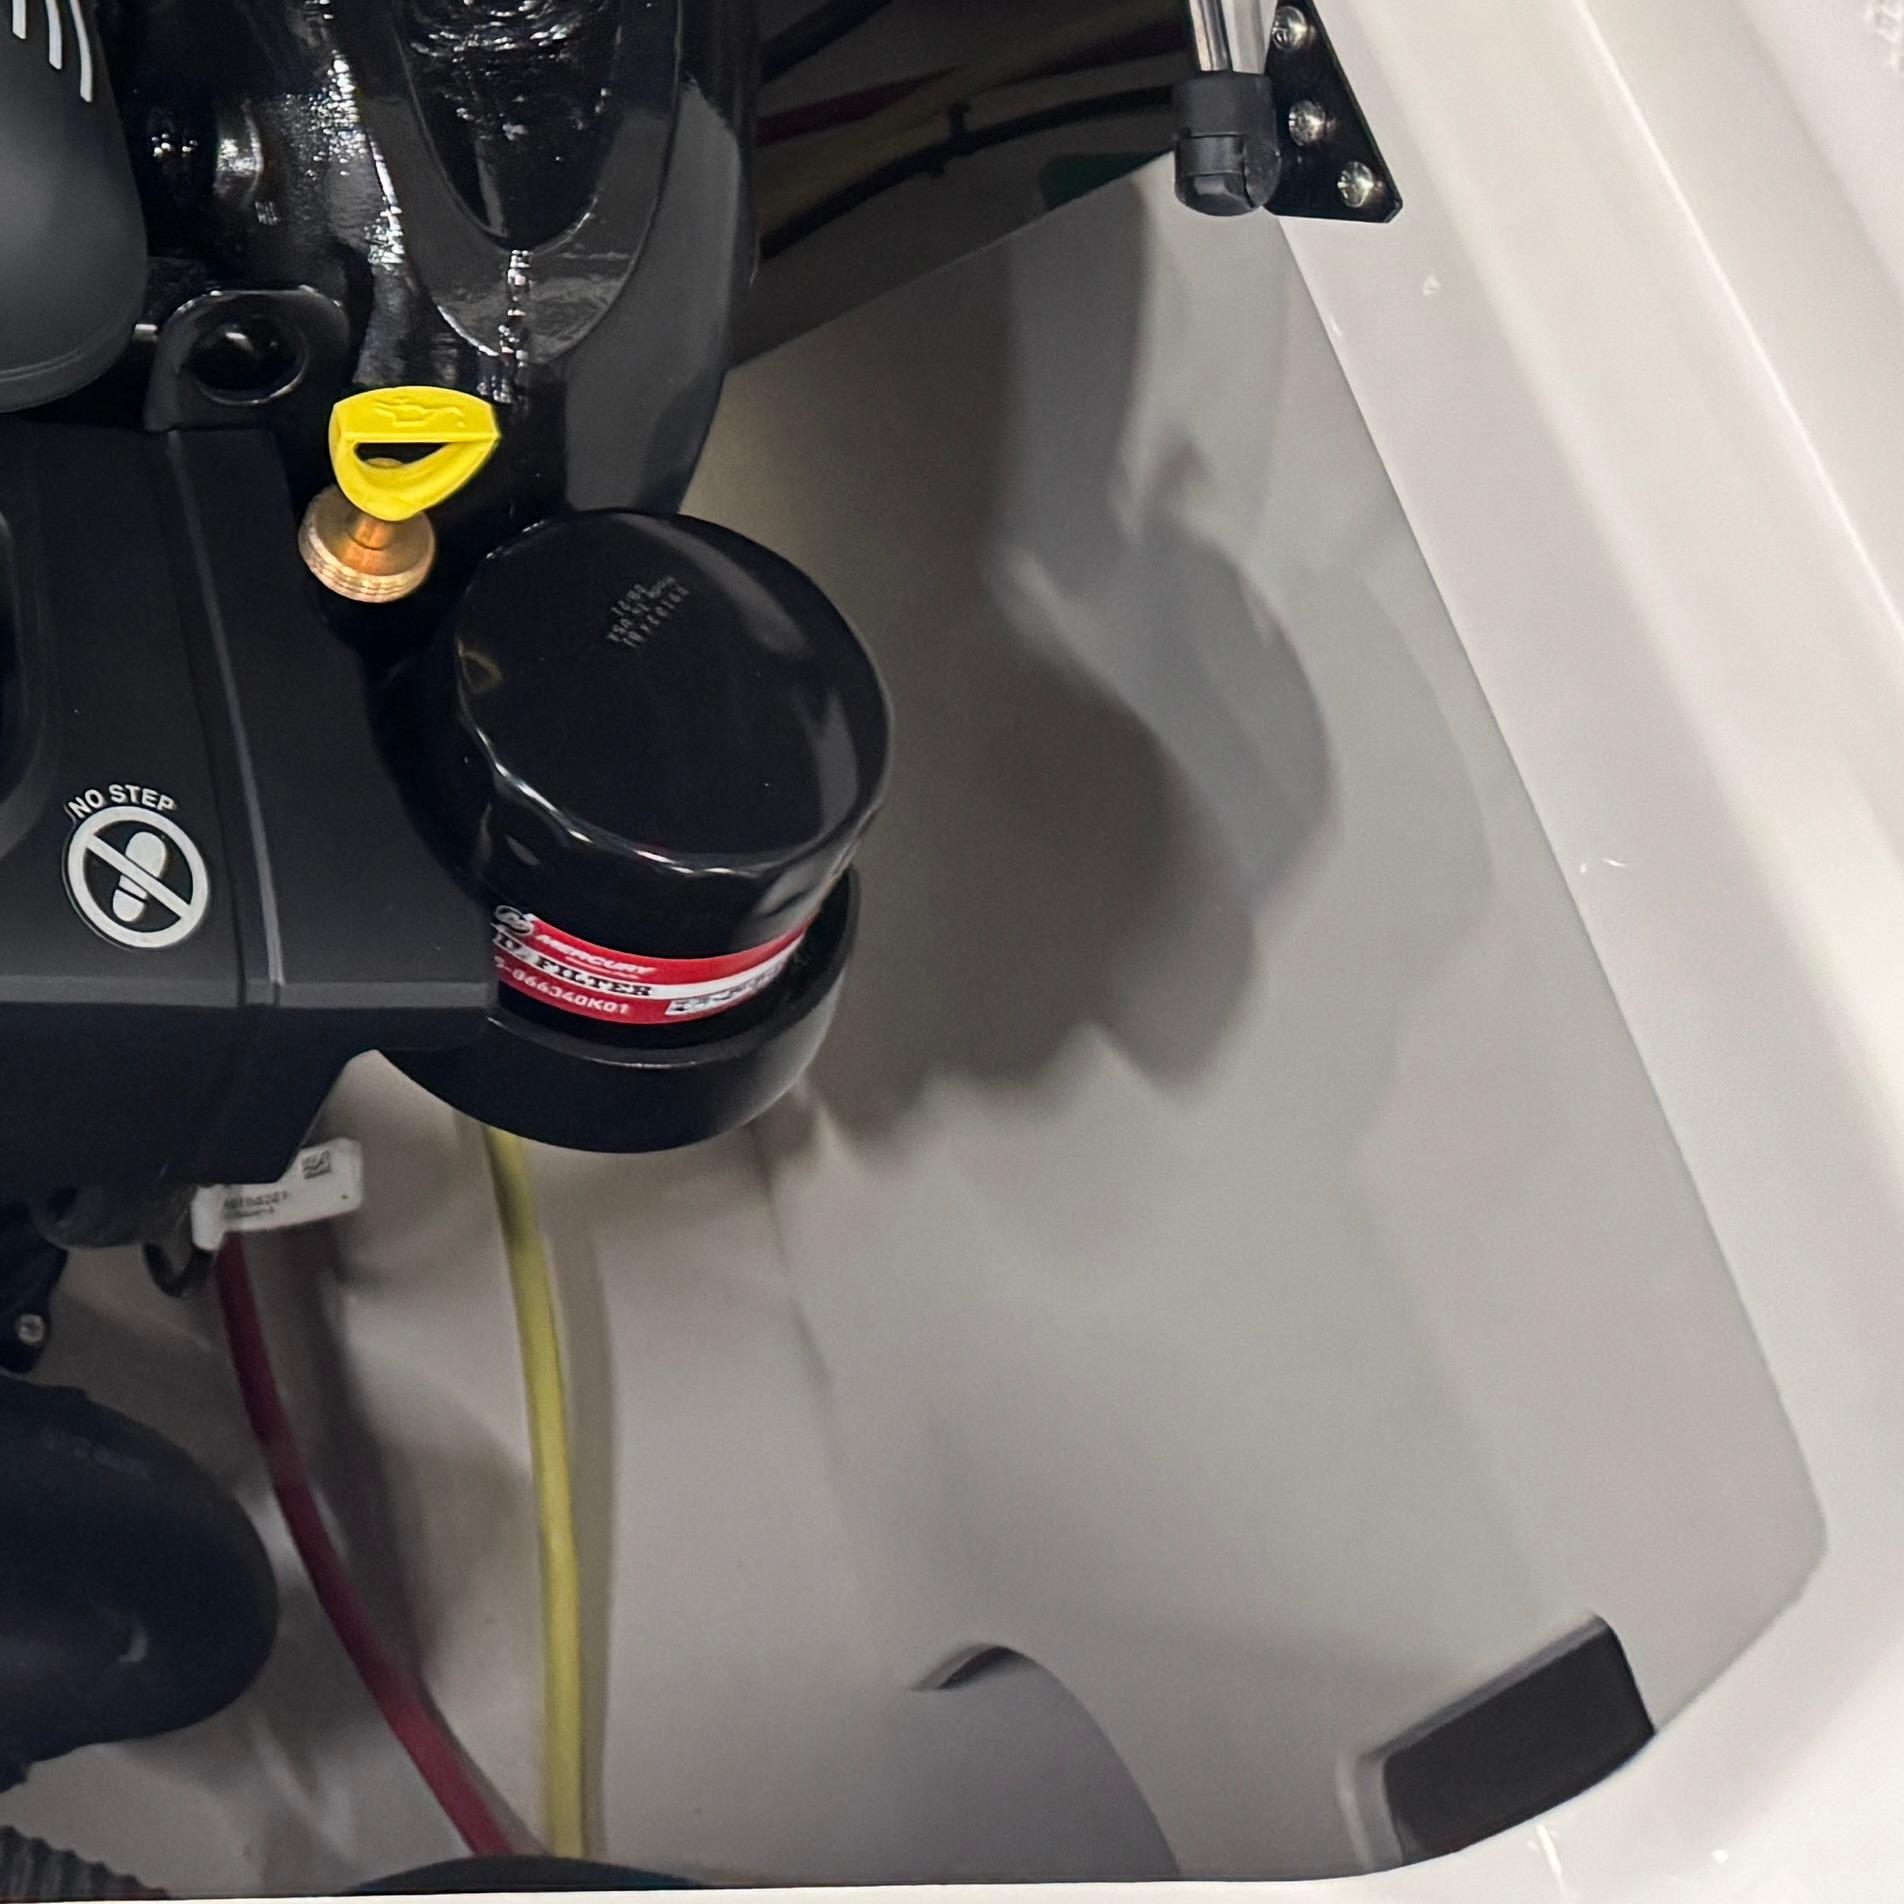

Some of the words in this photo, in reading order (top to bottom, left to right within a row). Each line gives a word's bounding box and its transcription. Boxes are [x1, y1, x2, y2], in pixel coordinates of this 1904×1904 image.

[68, 789, 104, 819] NO
[109, 784, 177, 811] STEP
[535, 935, 656, 975] MERCURY
